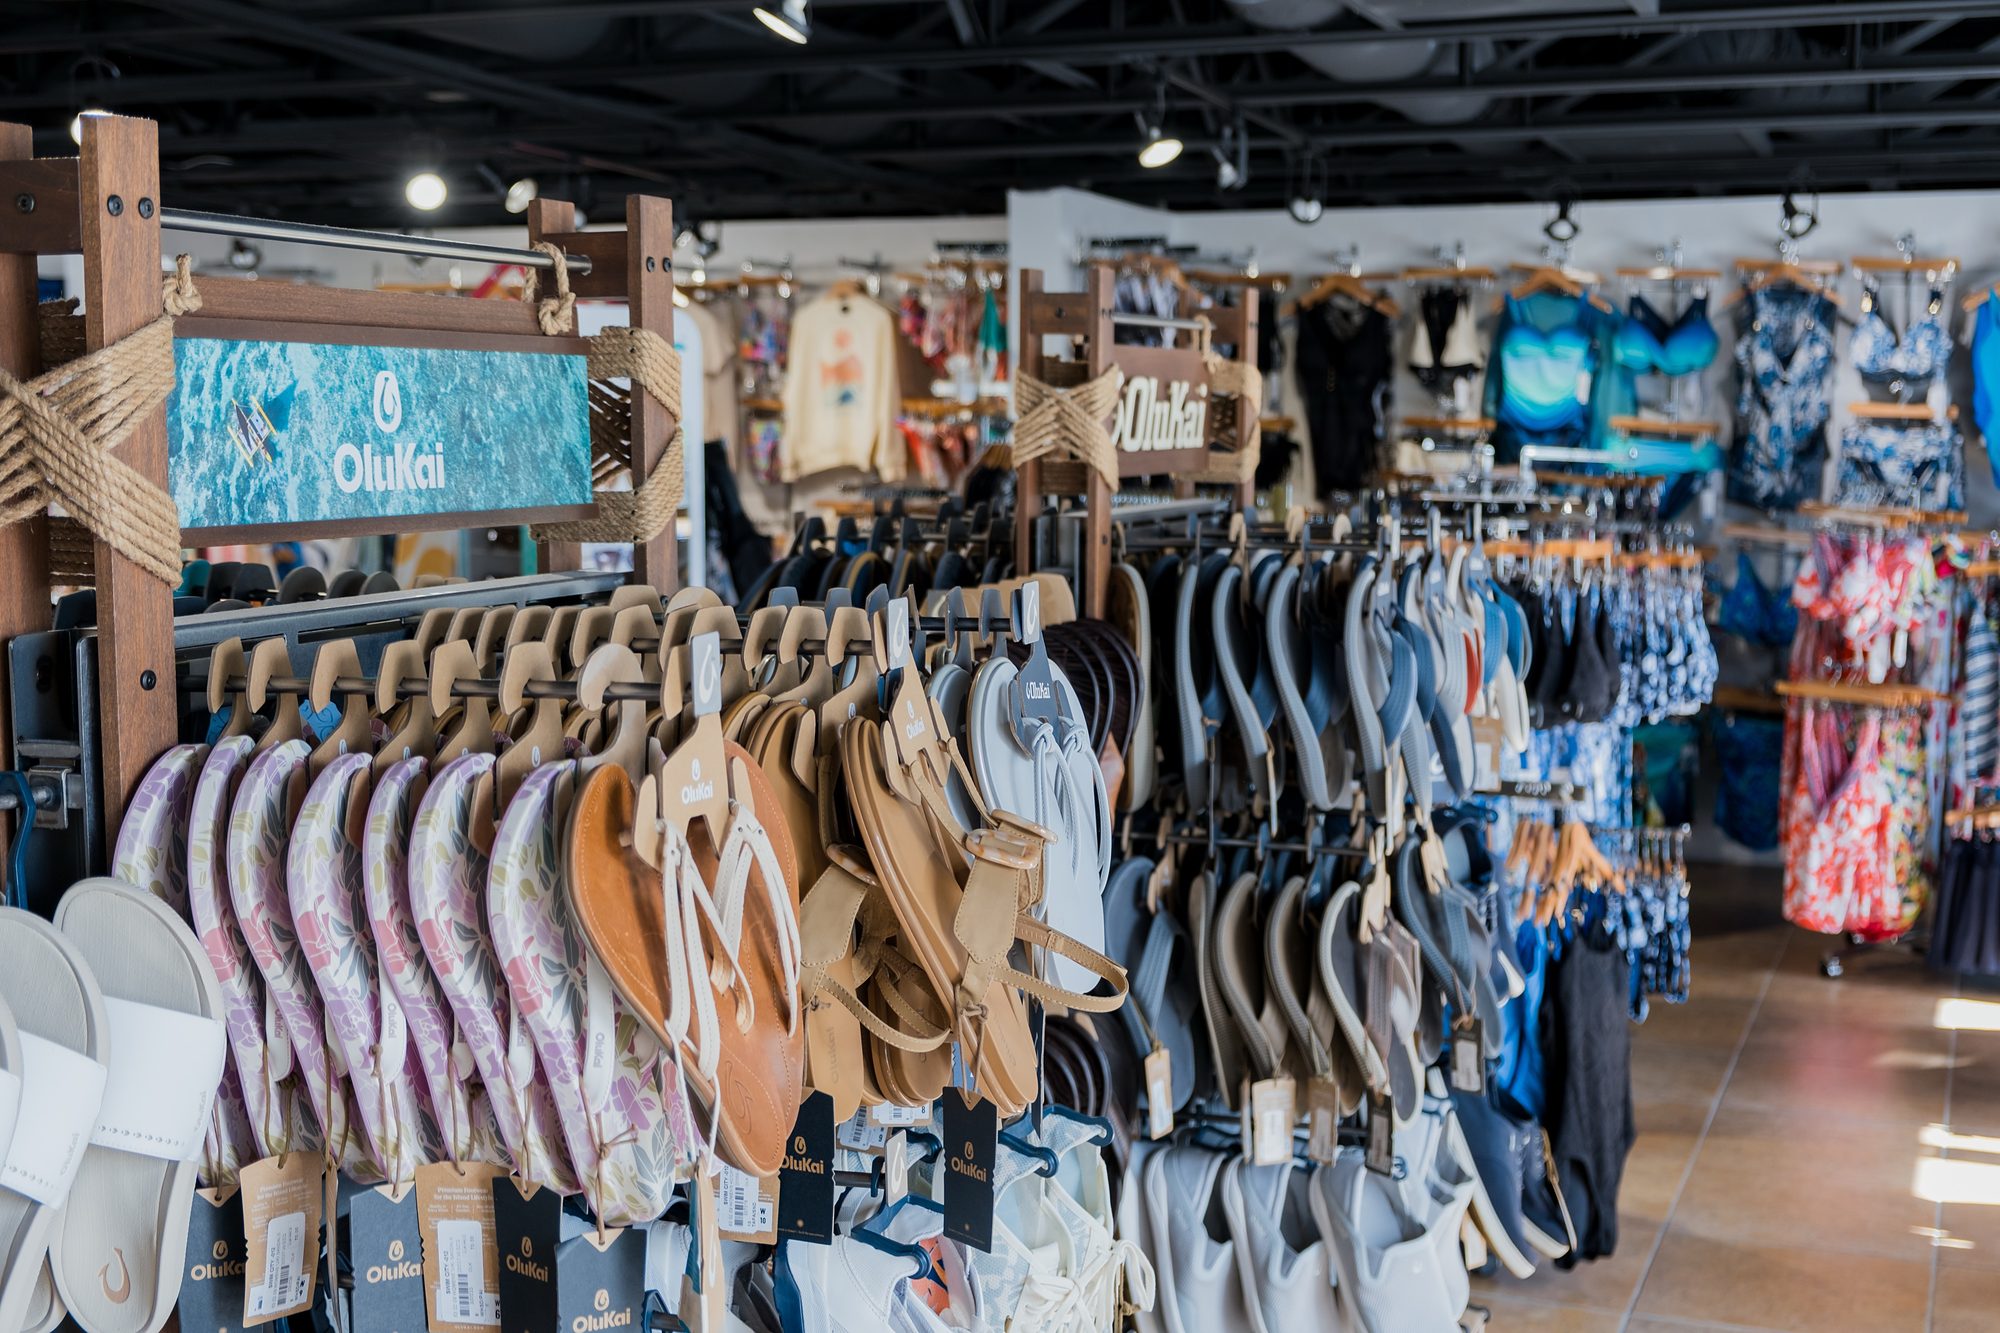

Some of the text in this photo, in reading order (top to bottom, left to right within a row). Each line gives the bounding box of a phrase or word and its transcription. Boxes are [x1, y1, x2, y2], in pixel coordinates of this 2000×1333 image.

[1123, 376, 1208, 452] OluKai
[333, 442, 445, 493] OluKai
[1030, 681, 1051, 699] OluKai
[905, 716, 926, 740] OluKai
[681, 780, 713, 805] OluKai
[386, 1003, 398, 1039] OluKai
[593, 1032, 606, 1068] OluKai
[951, 1157, 987, 1182] OluKai
[760, 1217, 767, 1225] 10
[190, 1261, 245, 1281] OluKa
[366, 1261, 422, 1284] OluKa
[506, 1254, 549, 1282] OluKai
[572, 1307, 631, 1333] OluKai
